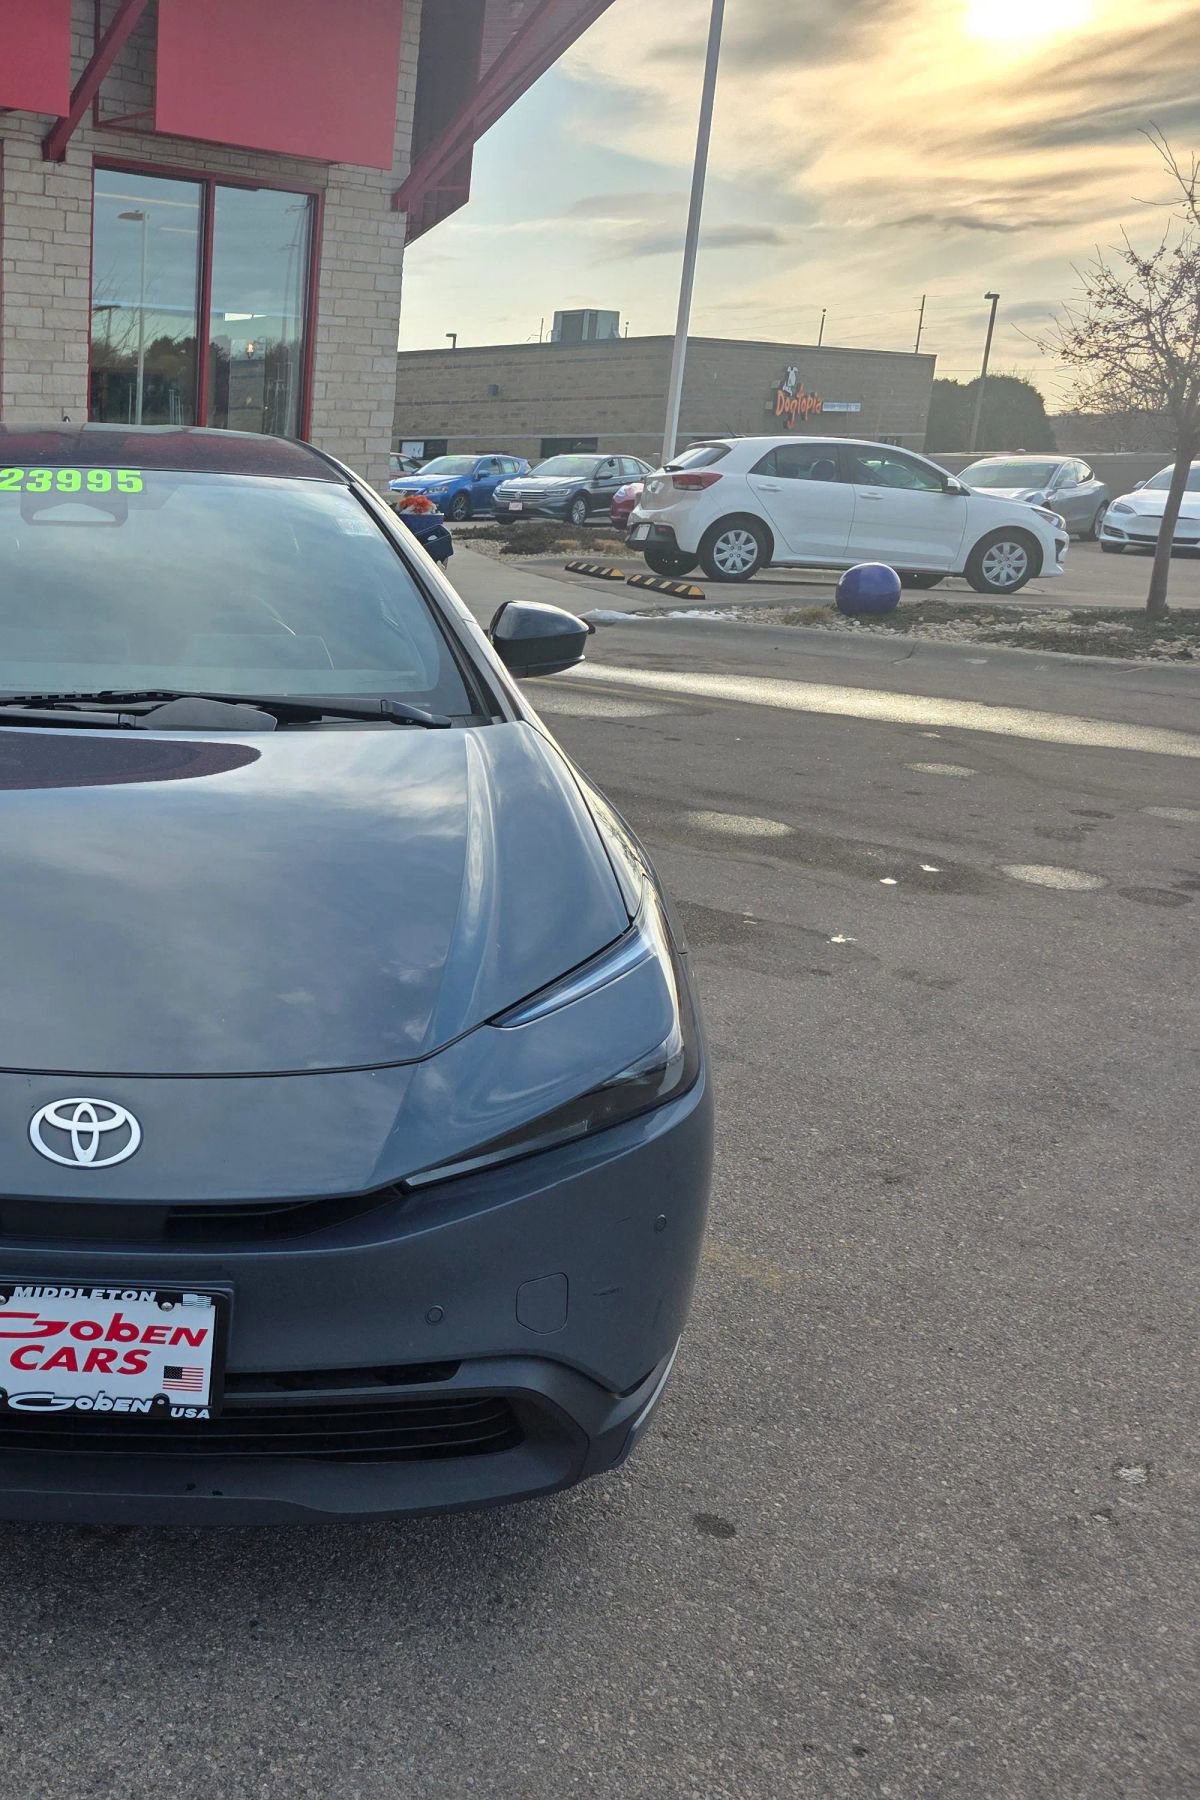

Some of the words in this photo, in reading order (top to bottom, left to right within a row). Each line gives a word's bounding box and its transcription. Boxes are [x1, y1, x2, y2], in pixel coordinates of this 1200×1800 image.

[775, 384, 823, 429] Dogtopia
[13, 1286, 157, 1302] MIDDLETON
[10, 1344, 152, 1376] CARS
[170, 1407, 211, 1420] USA
